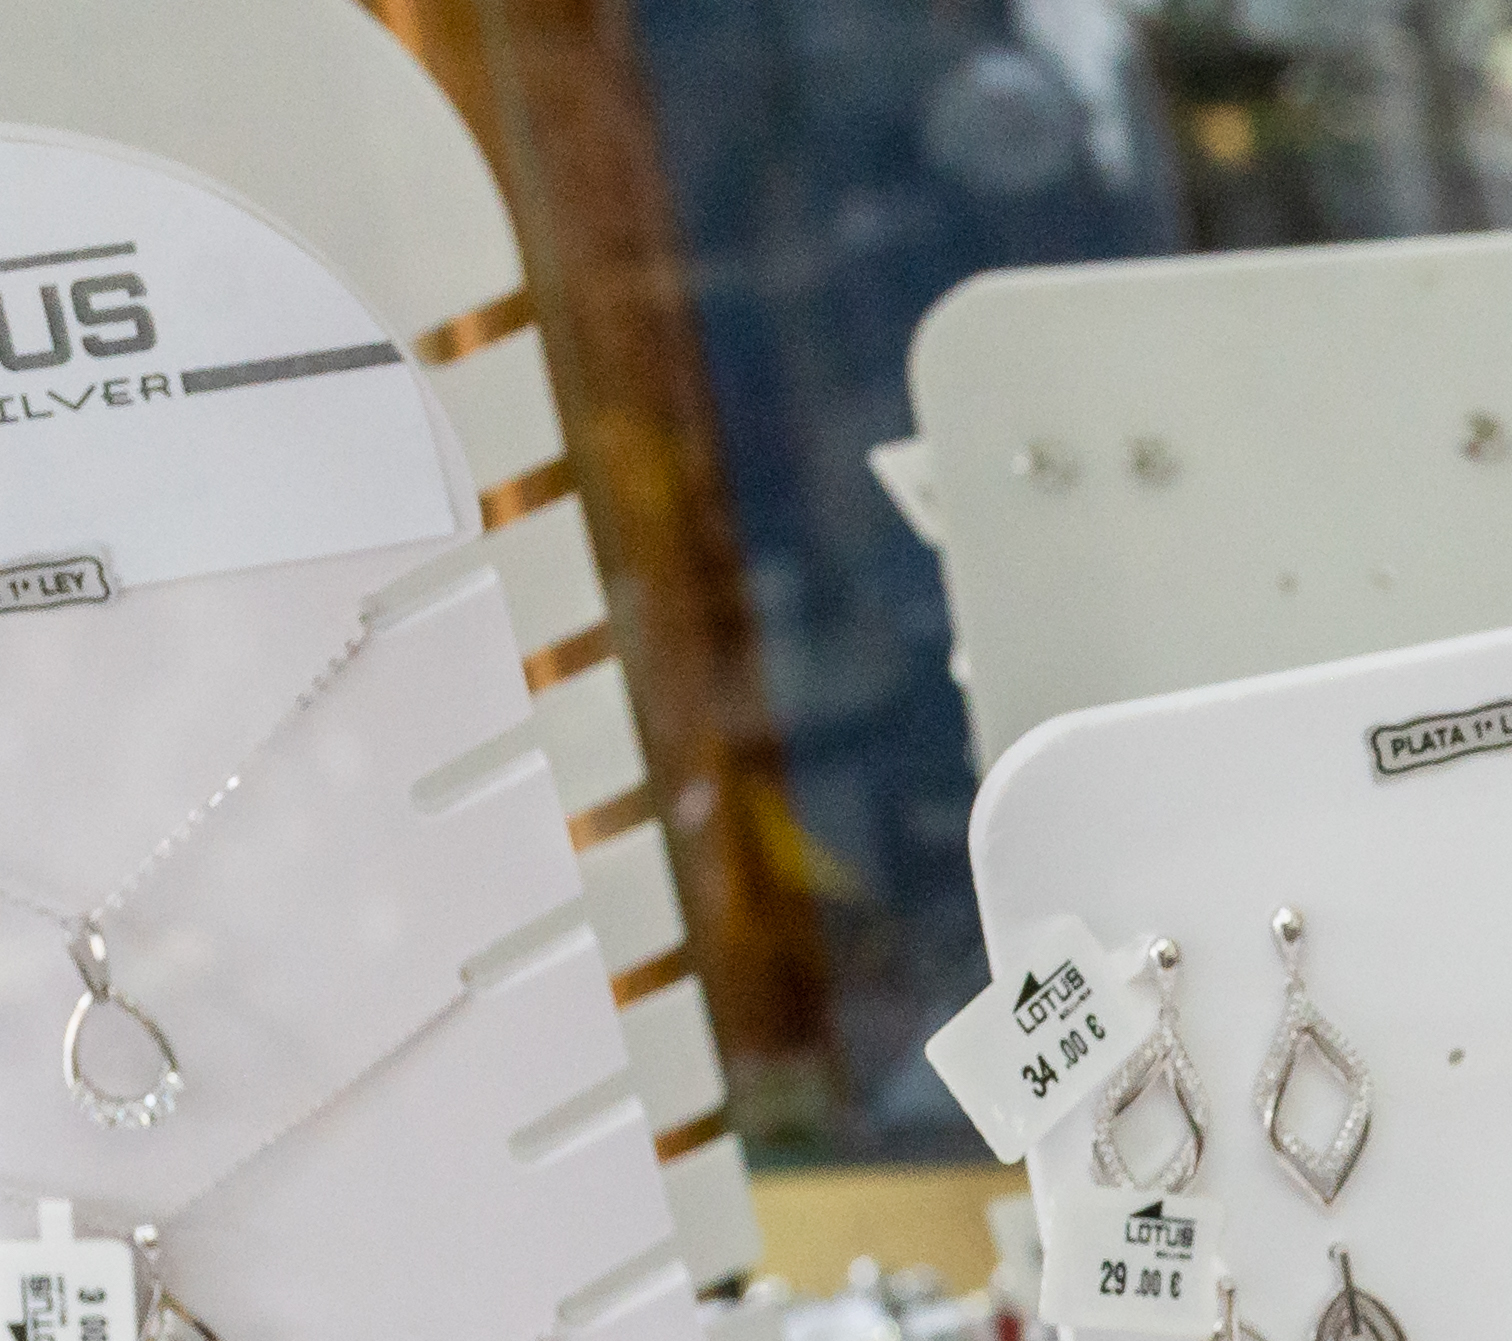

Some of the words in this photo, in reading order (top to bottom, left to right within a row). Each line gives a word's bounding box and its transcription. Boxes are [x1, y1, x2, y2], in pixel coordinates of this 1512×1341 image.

[0, 370, 173, 424] ILVER
[36, 570, 86, 597] LEY
[1390, 725, 1467, 758] PLATA
[1013, 966, 1087, 1036] LOTUS
[1021, 1053, 1059, 1098] 34
[1058, 1030, 1089, 1070] .00
[1085, 1013, 1106, 1040] €
[1125, 1220, 1195, 1248] LOTUS
[1099, 1258, 1127, 1296] 29
